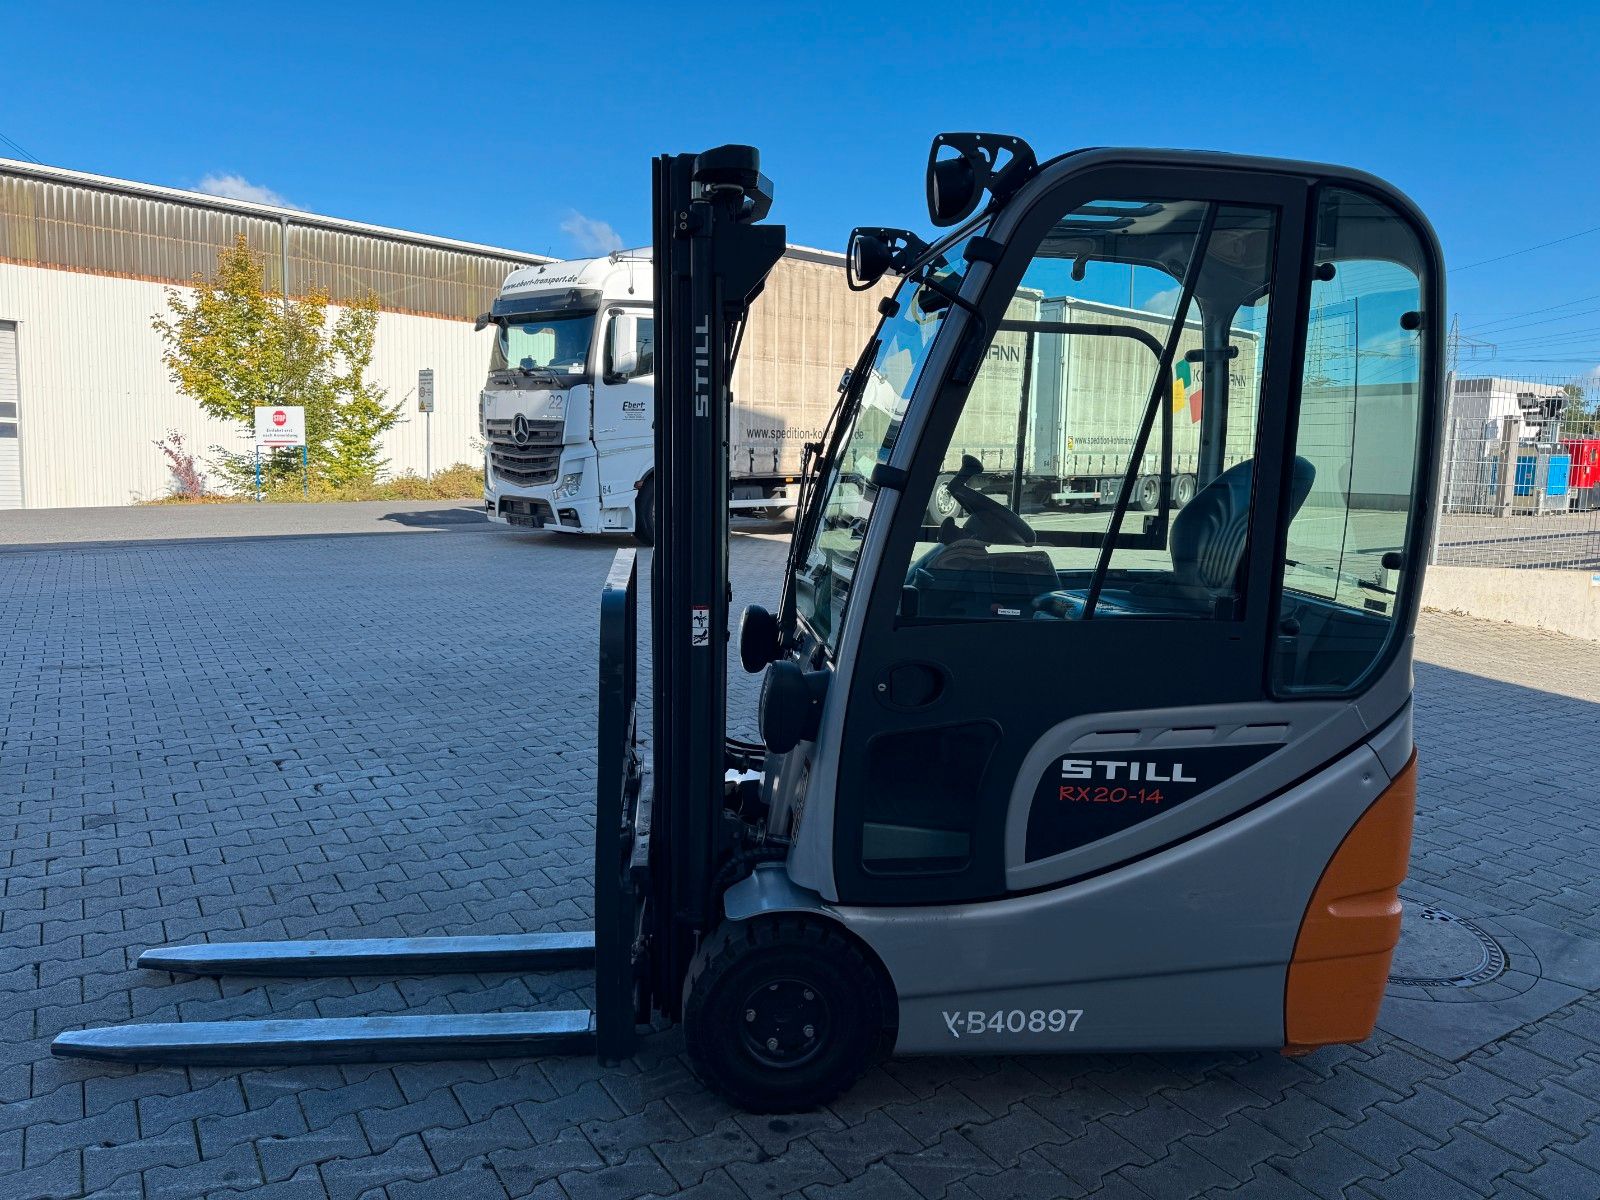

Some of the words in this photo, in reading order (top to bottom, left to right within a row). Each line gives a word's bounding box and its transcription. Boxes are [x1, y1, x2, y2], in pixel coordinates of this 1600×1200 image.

[503, 275, 577, 290] www.ebert-transport.de
[984, 345, 1020, 362] ANN
[696, 315, 708, 417] STILL
[549, 395, 562, 409] 22
[623, 401, 645, 411] Ebert
[273, 414, 286, 422] STOP
[747, 427, 864, 440] www.spedition-ko.de
[1062, 759, 1196, 783] STILL
[1059, 785, 1164, 804] RX20-14
